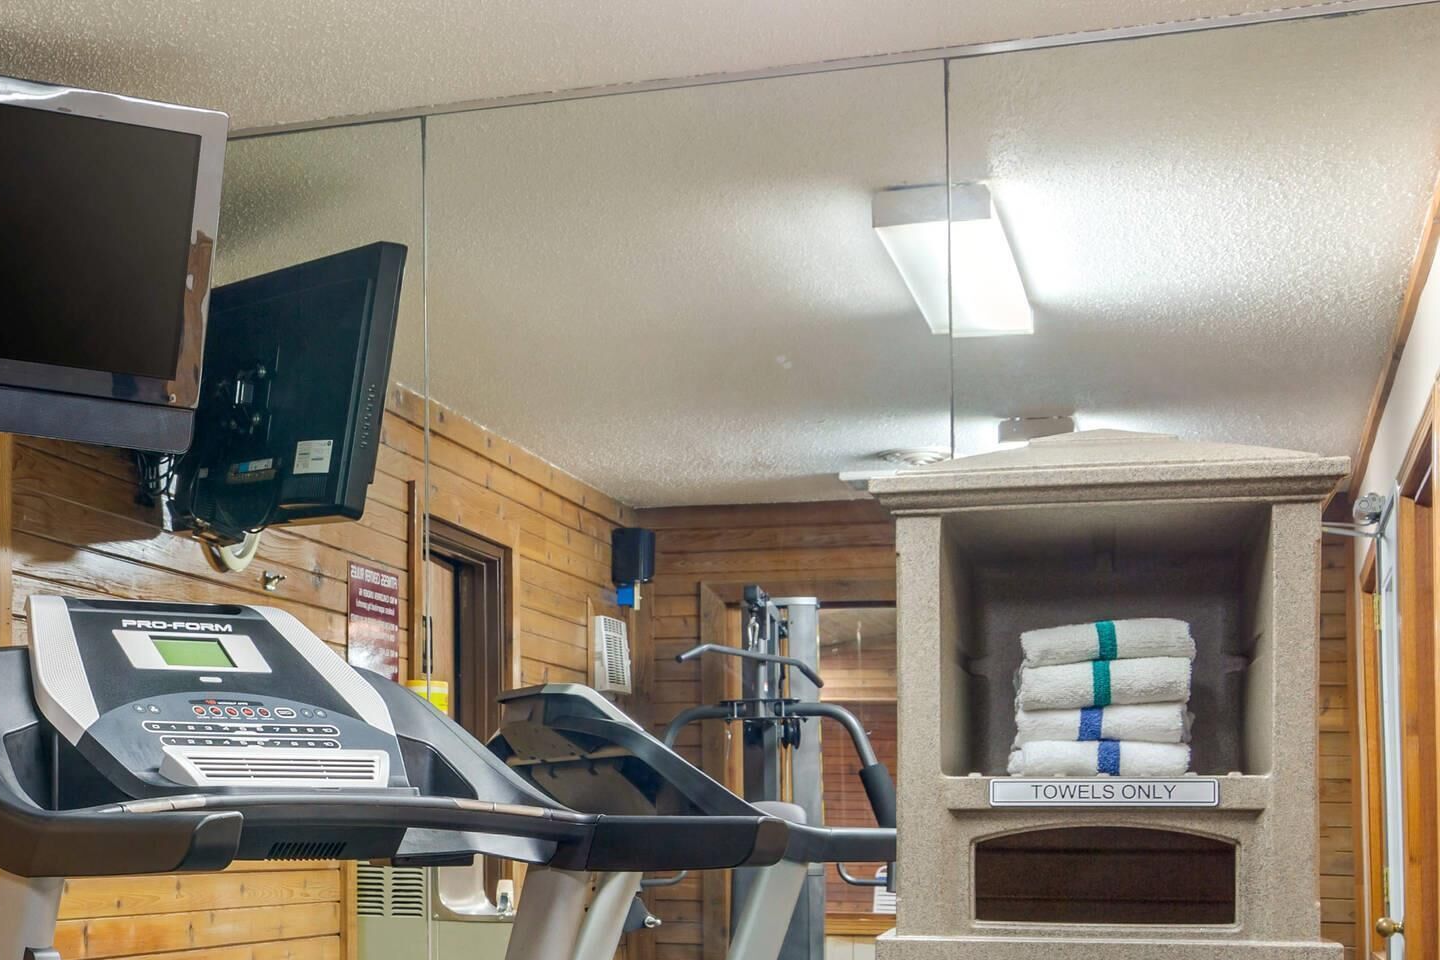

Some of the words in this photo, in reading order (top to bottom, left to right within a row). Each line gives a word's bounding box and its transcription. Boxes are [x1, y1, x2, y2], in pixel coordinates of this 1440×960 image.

[121, 619, 233, 632] PRO-FORM
[1031, 784, 1115, 800] TOWELS
[1121, 784, 1176, 800] ONLY
